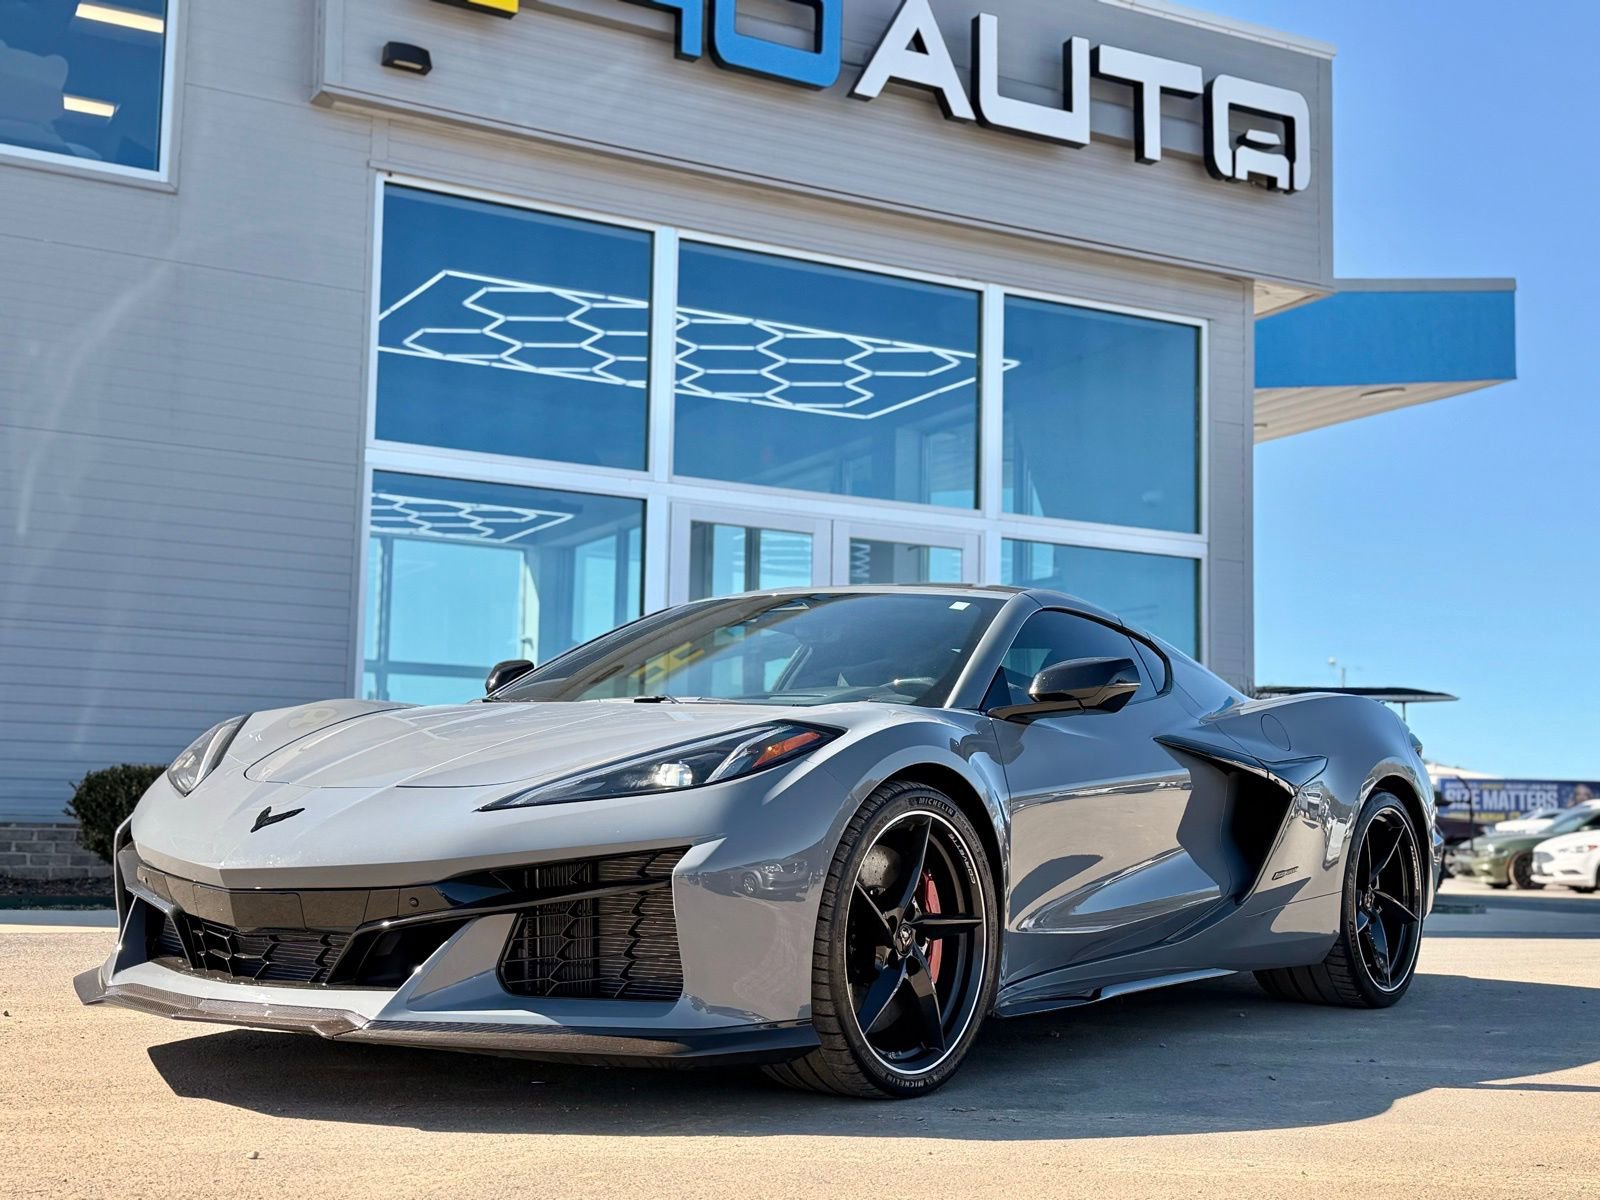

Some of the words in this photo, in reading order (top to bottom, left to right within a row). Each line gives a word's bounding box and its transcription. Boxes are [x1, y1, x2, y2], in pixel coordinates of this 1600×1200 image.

[918, 797, 955, 816] MICHELIN
[1482, 790, 1559, 811] MATTERS
[948, 833, 976, 885] CORVETTE
[885, 1073, 926, 1088] MICHELIN
